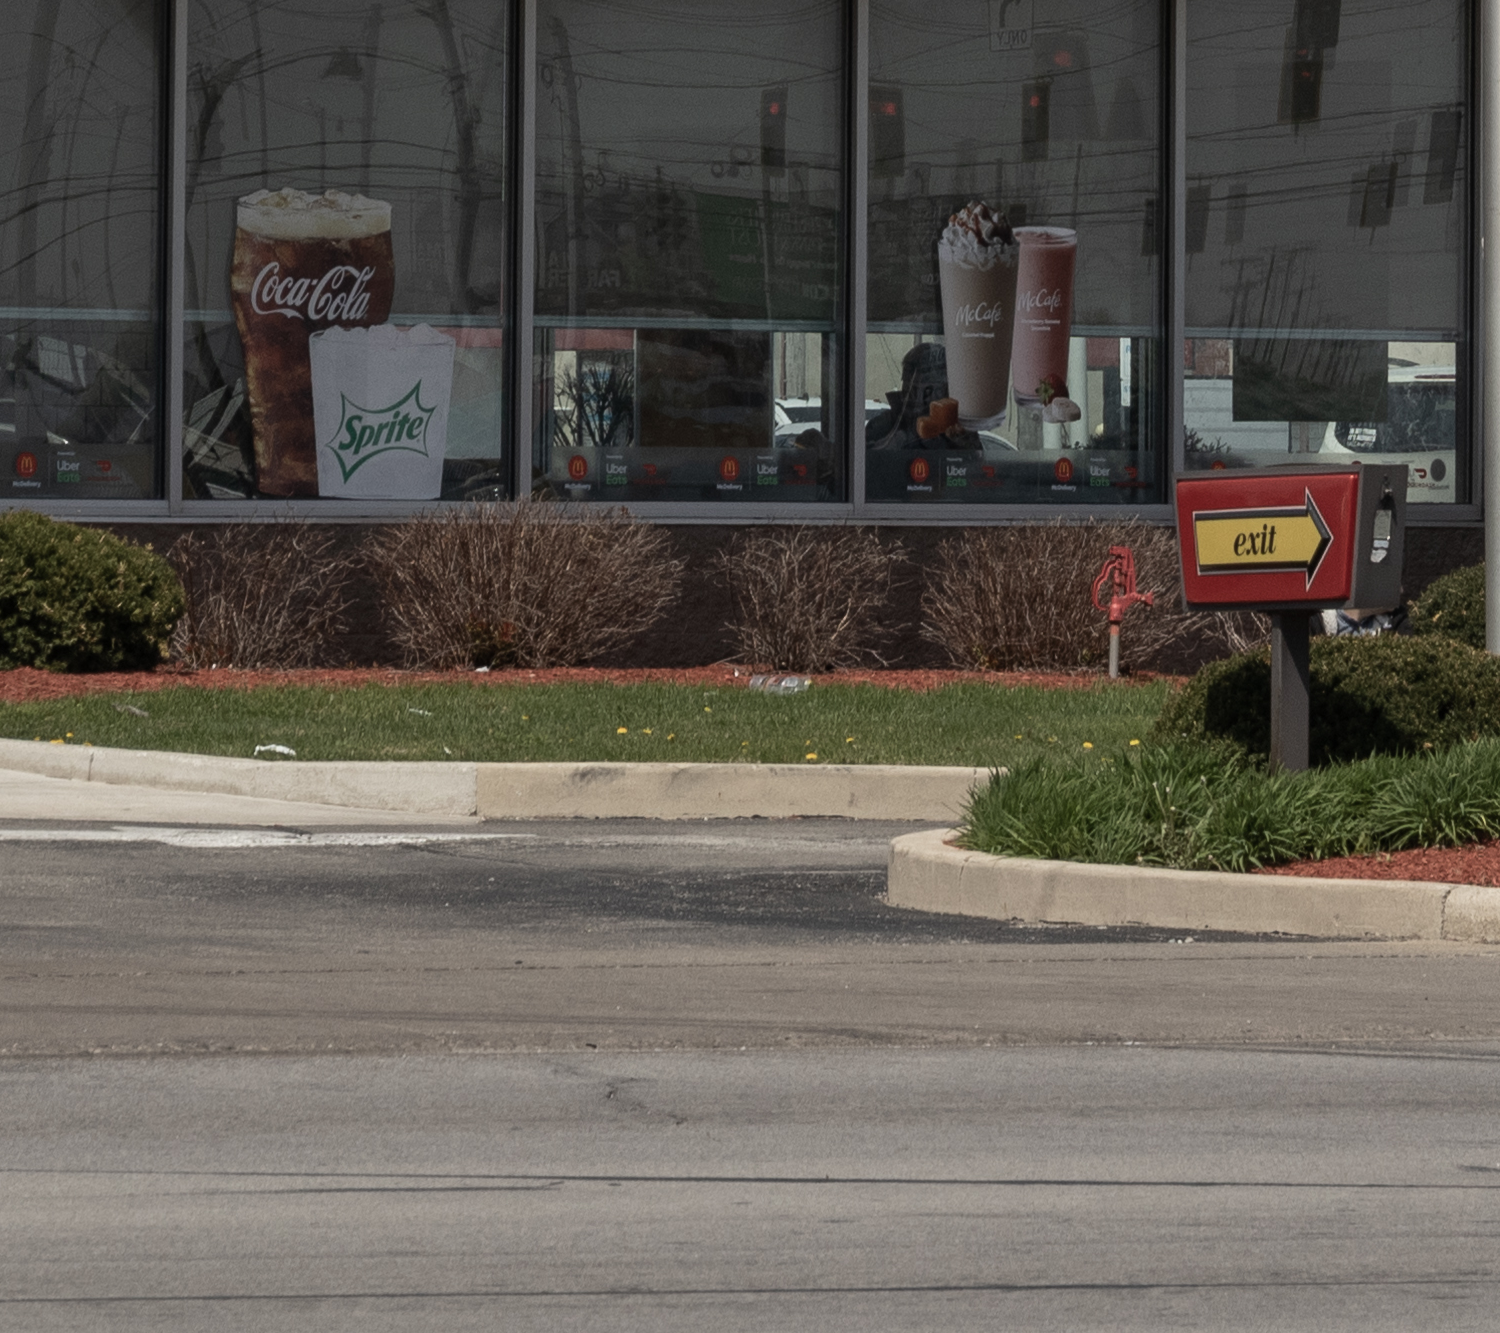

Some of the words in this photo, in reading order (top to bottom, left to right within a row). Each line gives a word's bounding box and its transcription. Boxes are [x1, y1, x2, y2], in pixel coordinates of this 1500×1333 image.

[251, 262, 376, 320] Coca-Cola
[955, 302, 1002, 327] McCafé
[338, 410, 424, 455] Sprite
[57, 460, 80, 471] Uber
[606, 463, 627, 474] Uber
[757, 464, 778, 474] Uber
[946, 466, 967, 476] Uber
[1233, 524, 1277, 556] exit
